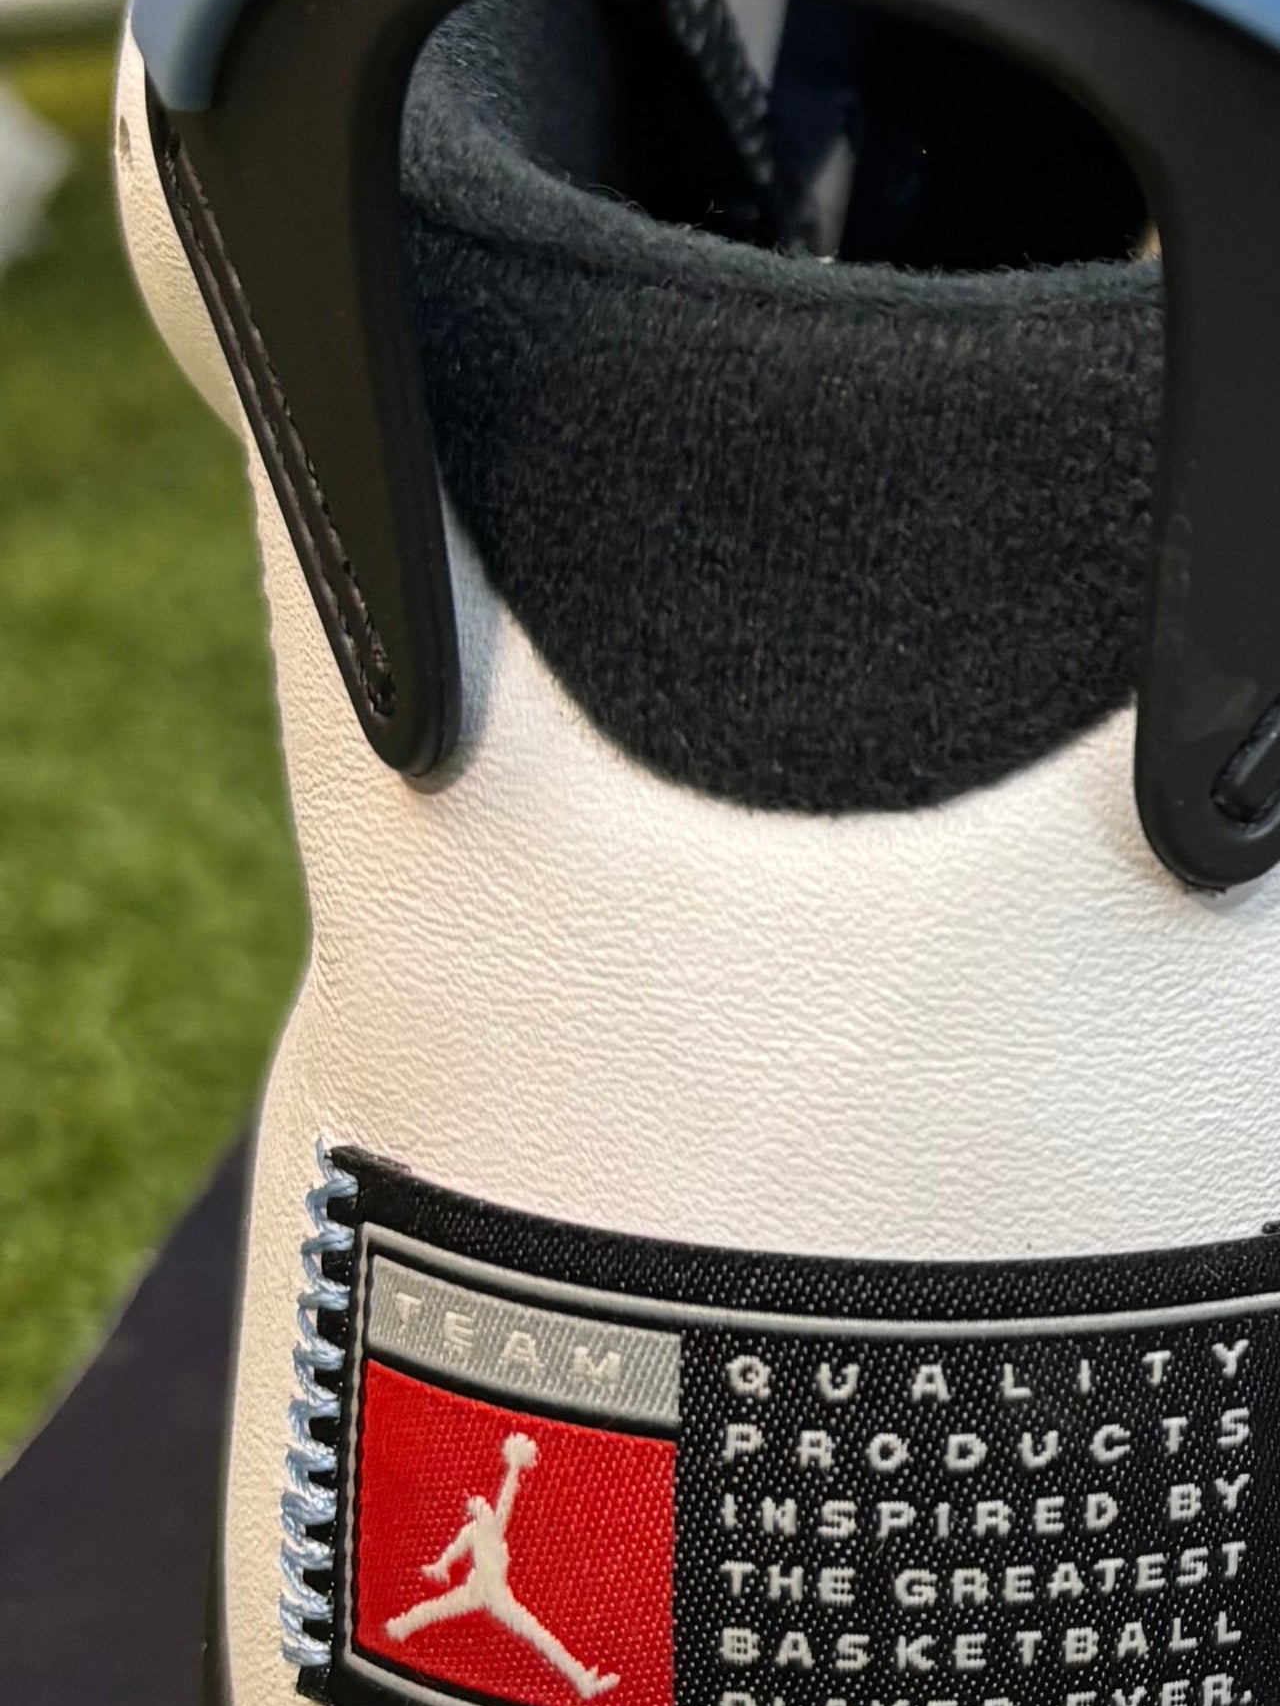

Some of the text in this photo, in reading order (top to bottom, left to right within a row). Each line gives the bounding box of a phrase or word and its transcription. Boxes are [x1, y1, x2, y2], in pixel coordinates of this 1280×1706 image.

[396, 1291, 623, 1385] TEAM
[726, 1338, 1250, 1400] QUALITY
[721, 1407, 1252, 1473] PRODUCTS
[720, 1473, 1250, 1539] INSPIRED BY
[719, 1540, 1247, 1607] THE GREATEST
[720, 1610, 1242, 1671] BASKETBALL
